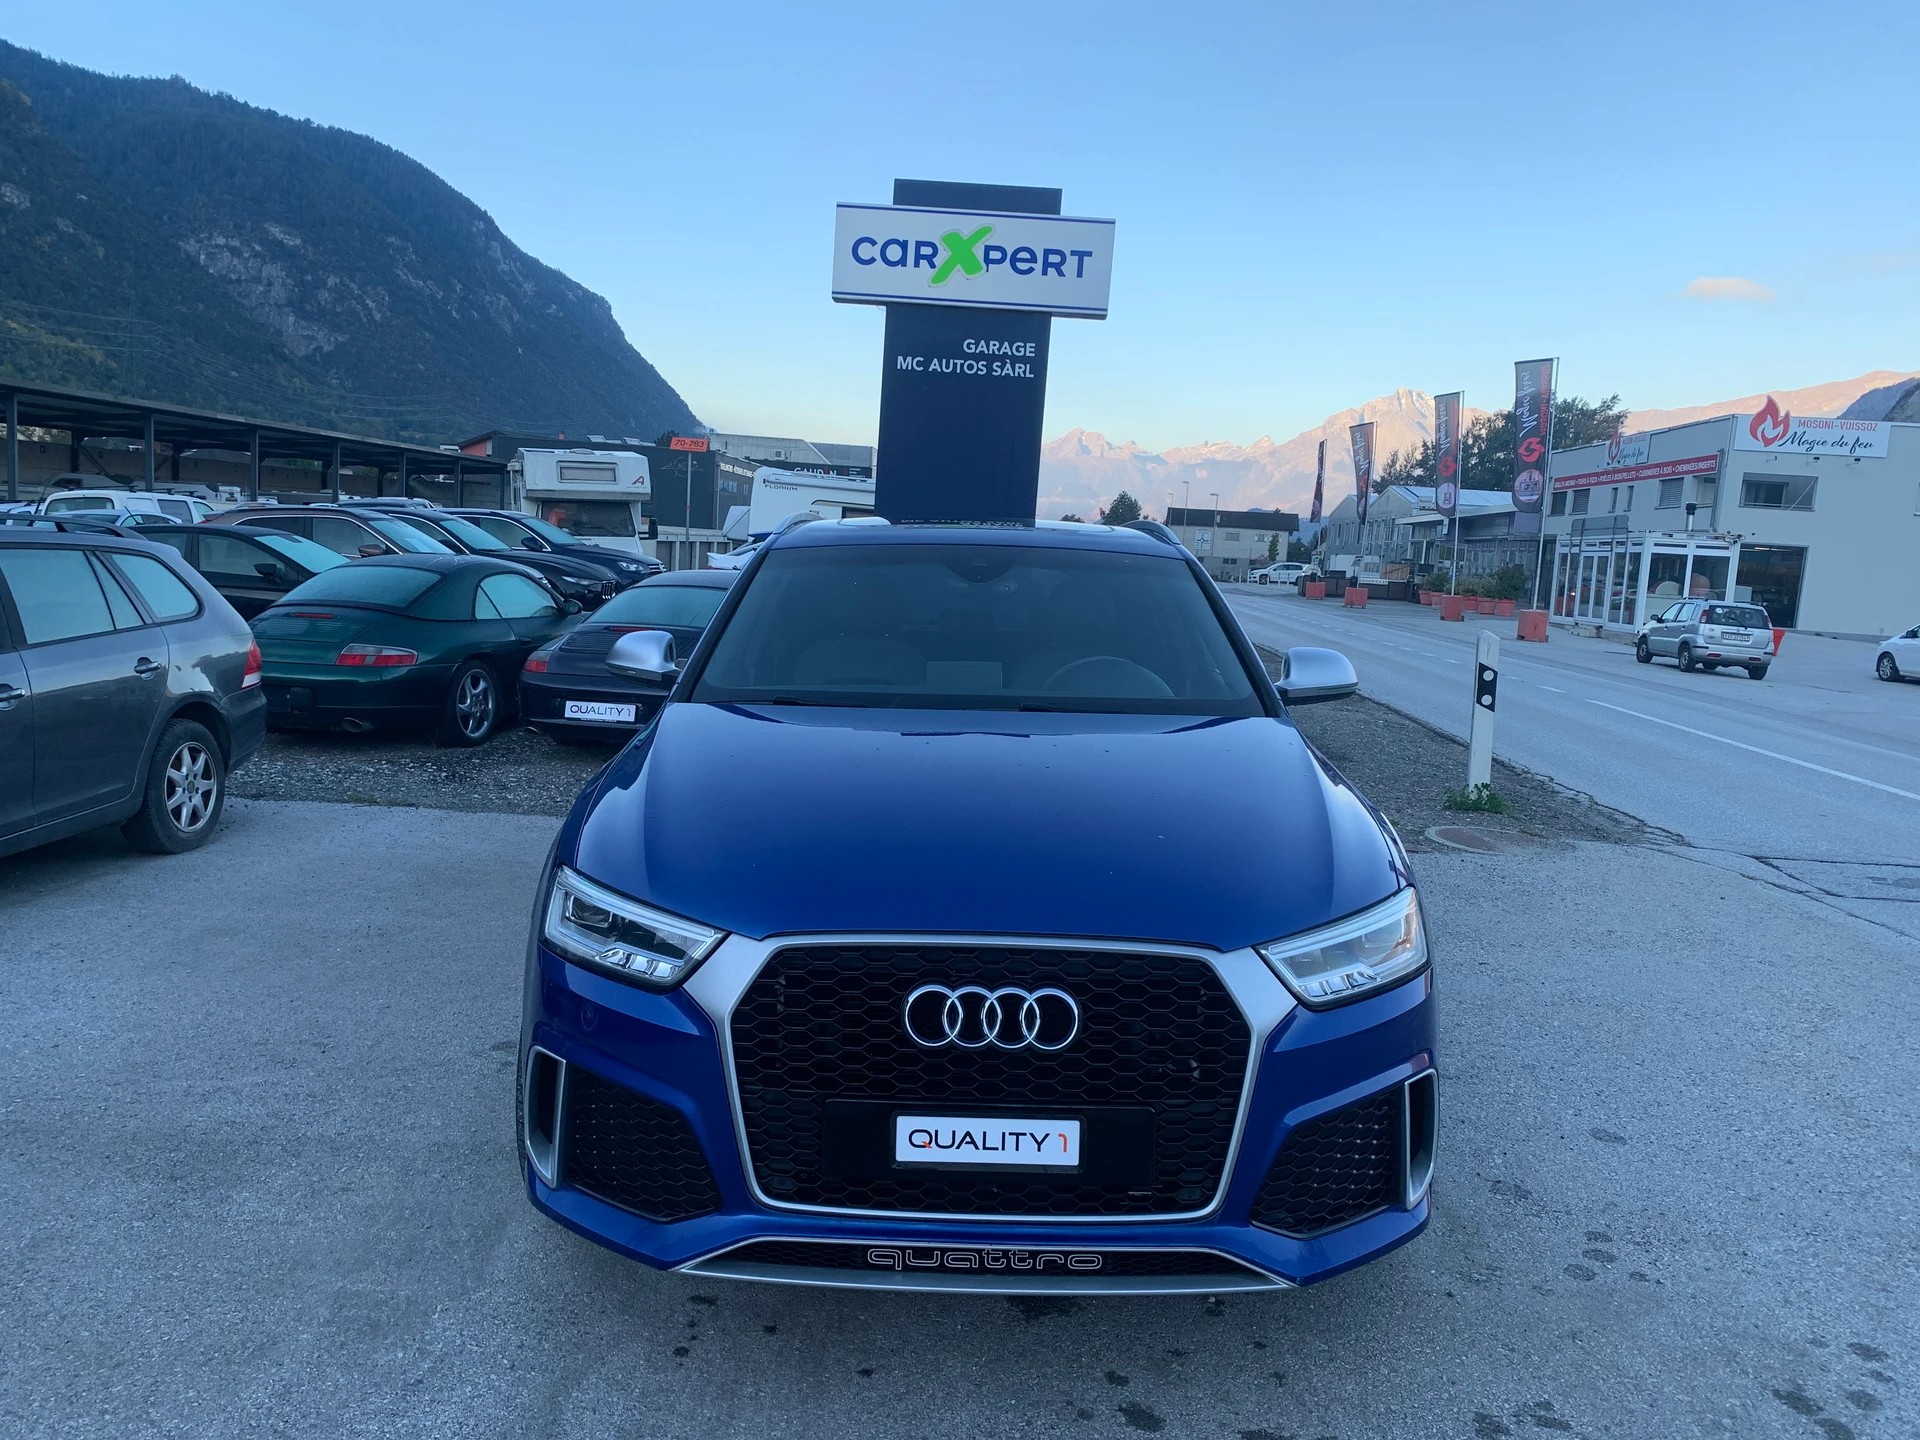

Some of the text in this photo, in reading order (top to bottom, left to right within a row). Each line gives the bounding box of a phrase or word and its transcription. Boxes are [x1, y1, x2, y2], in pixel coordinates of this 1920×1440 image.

[962, 338, 1036, 358] GARAGE
[896, 355, 1035, 378] MC AUTOS SÀRL
[1797, 418, 1878, 433] MOSONI-VUISSOZ
[674, 439, 705, 448] 70-783
[1777, 430, 1875, 455] Magie du feu
[569, 703, 625, 717] QUALITY
[908, 1129, 1051, 1153] QUALITY
[867, 1248, 1103, 1270] quattro
